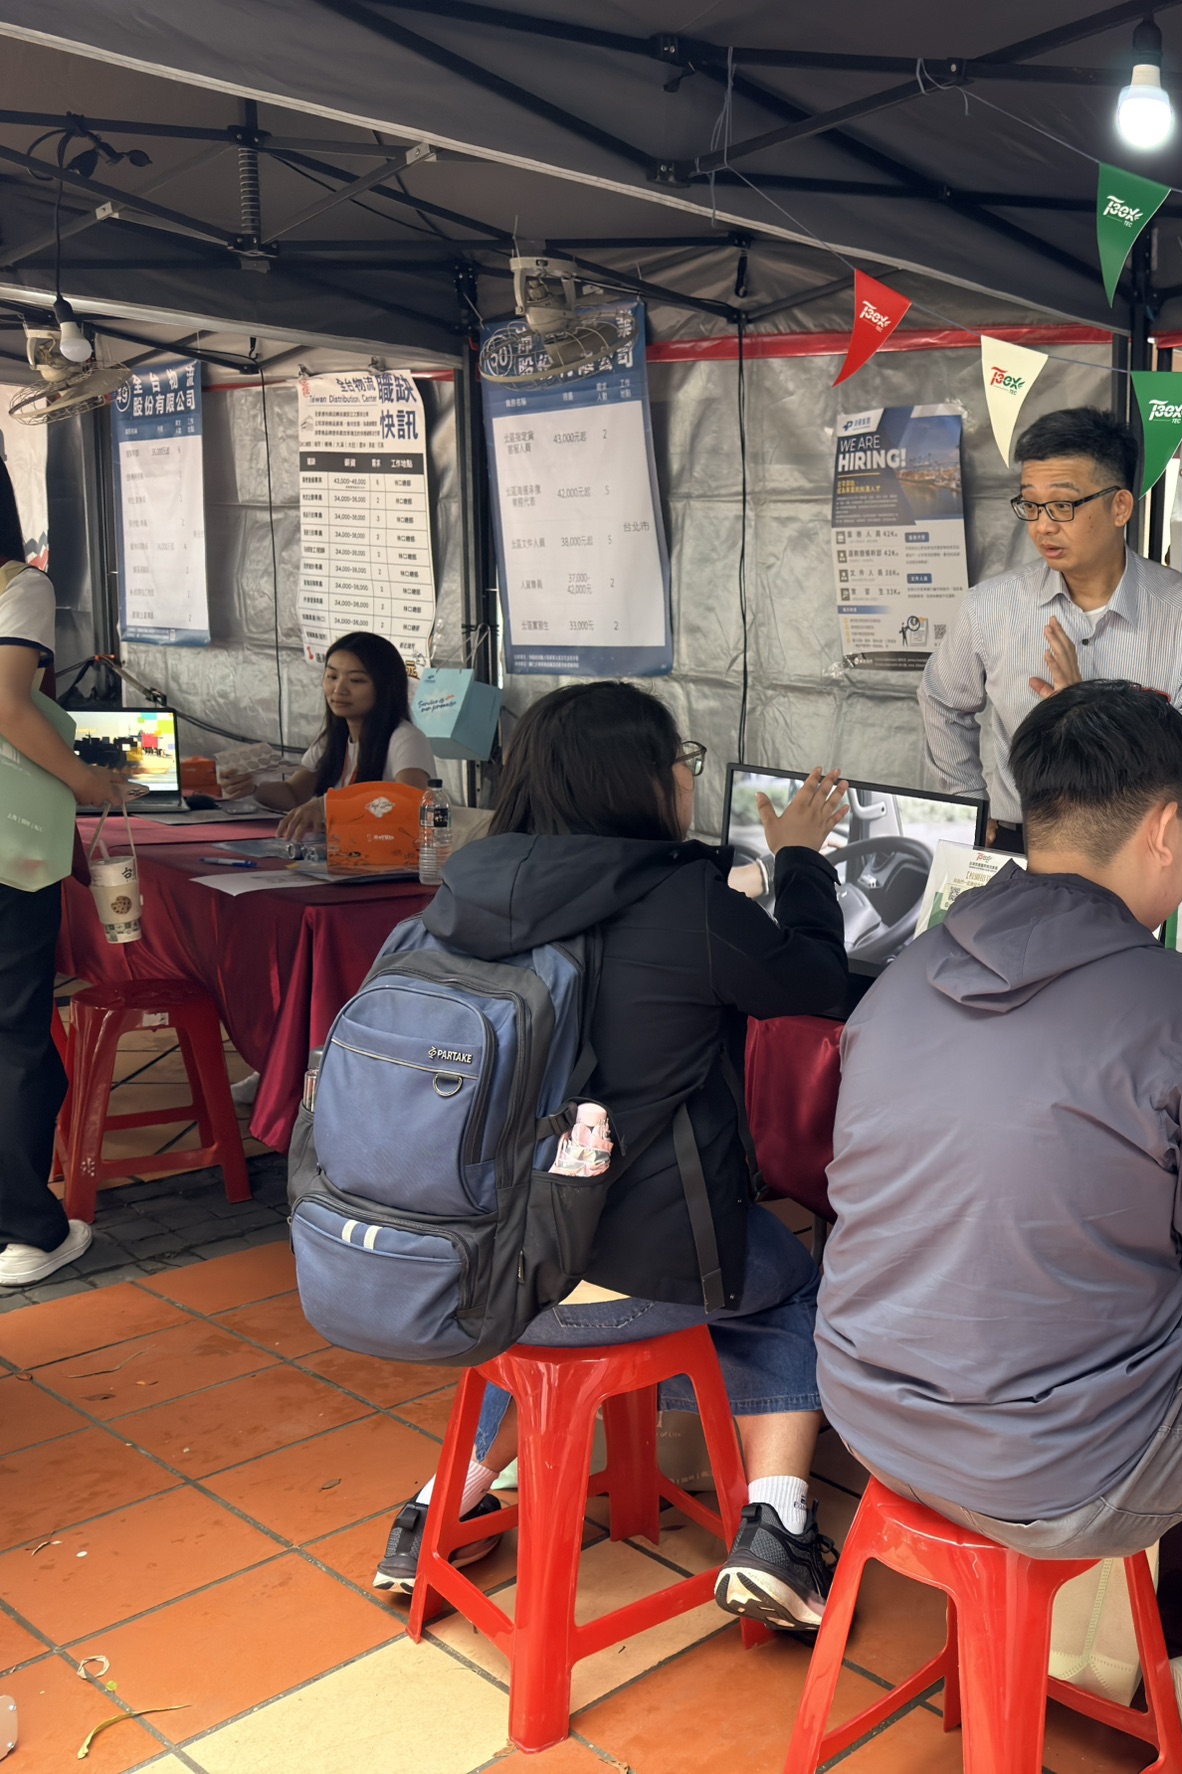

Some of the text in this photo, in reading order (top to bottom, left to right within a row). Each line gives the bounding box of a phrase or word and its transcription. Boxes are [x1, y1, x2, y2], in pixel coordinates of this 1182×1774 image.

[1123, 220, 1133, 228] TEC
[336, 376, 376, 393] 全台物流
[375, 374, 417, 404] 職缺
[1009, 388, 1018, 396] TEC
[133, 389, 196, 417] 股份有限公司
[380, 409, 418, 440] 快訊
[1171, 416, 1182, 424] TEC
[840, 435, 880, 452] WE ARE
[838, 448, 906, 472] HIRING!
[624, 521, 650, 532] 台北市
[437, 1048, 473, 1064] PARTAKE
